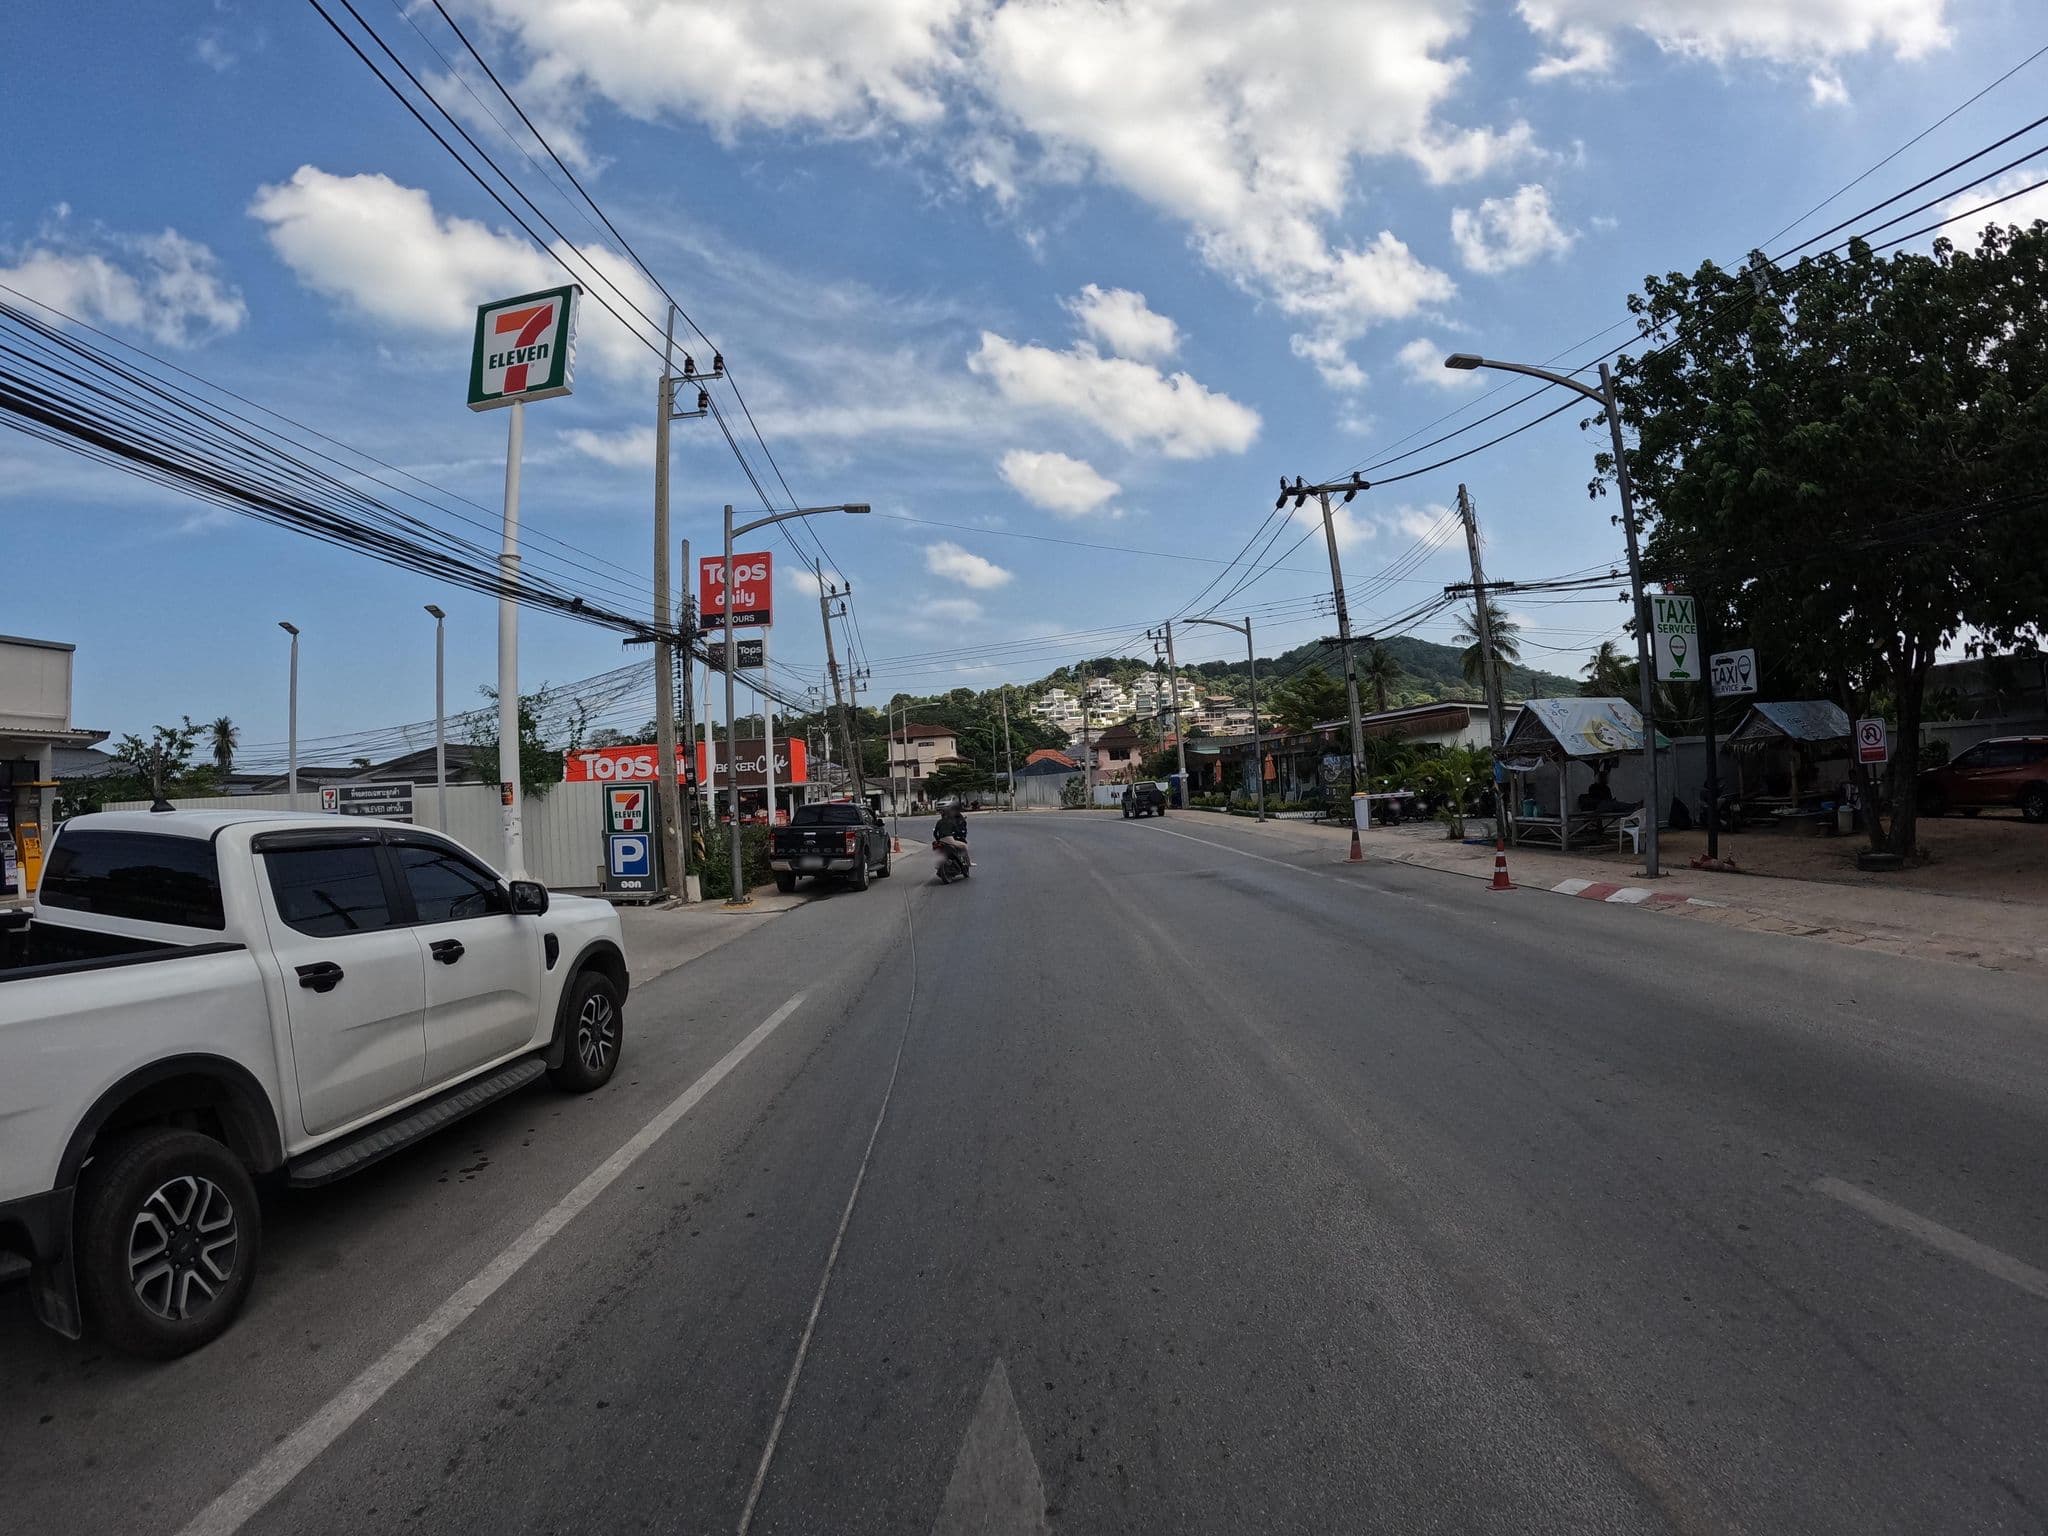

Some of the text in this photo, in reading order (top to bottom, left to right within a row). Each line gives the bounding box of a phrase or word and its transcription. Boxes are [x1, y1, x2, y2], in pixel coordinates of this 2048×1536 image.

[495, 304, 553, 394] 7
[715, 589, 756, 607] dily
[729, 615, 755, 624] OURS
[1654, 598, 1695, 624] TAXI
[1656, 623, 1696, 634] SERVICE
[738, 645, 762, 656] Tops
[1712, 665, 1738, 684] TAXI
[579, 753, 652, 781] Tops
